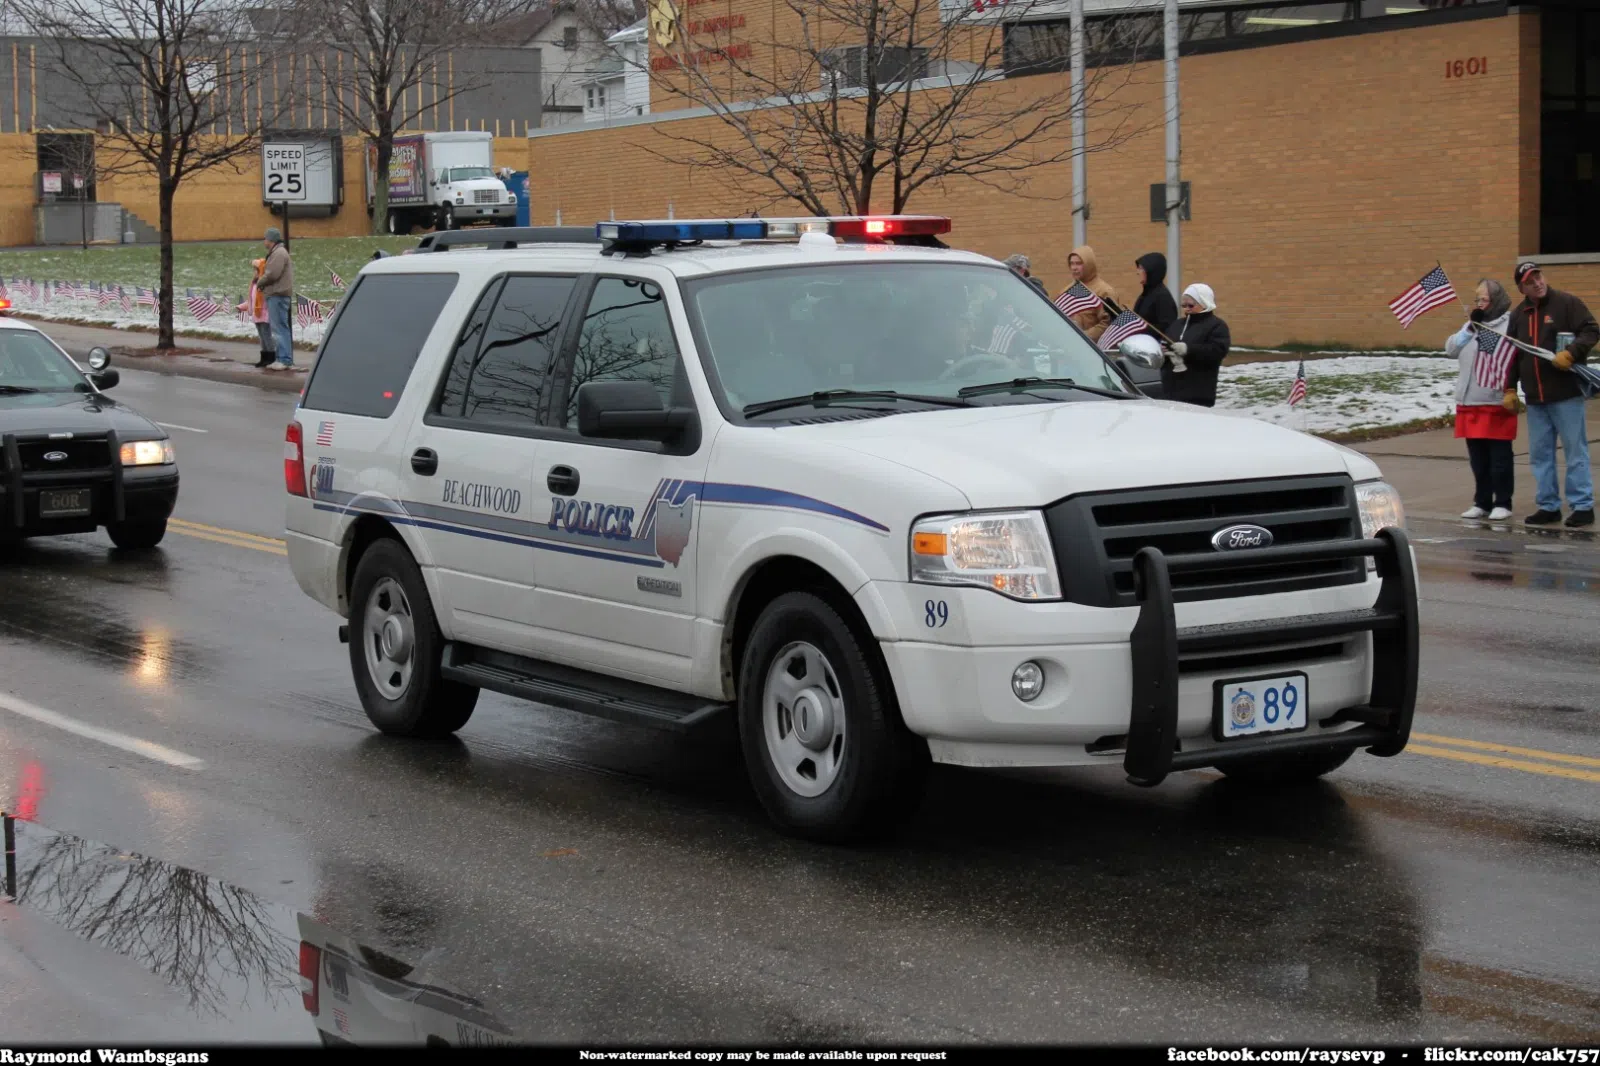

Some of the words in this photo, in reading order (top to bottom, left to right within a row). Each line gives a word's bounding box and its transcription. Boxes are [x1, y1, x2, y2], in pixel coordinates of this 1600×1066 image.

[1445, 56, 1487, 78] 1601
[266, 150, 302, 159] SPEED
[270, 162, 298, 171] LIMIT
[268, 173, 302, 193] 25
[442, 479, 521, 514] BEACHWOOD
[548, 497, 634, 540] POLICE
[1229, 529, 1262, 548] Ford
[924, 599, 949, 628] 89
[1263, 684, 1298, 724] 89
